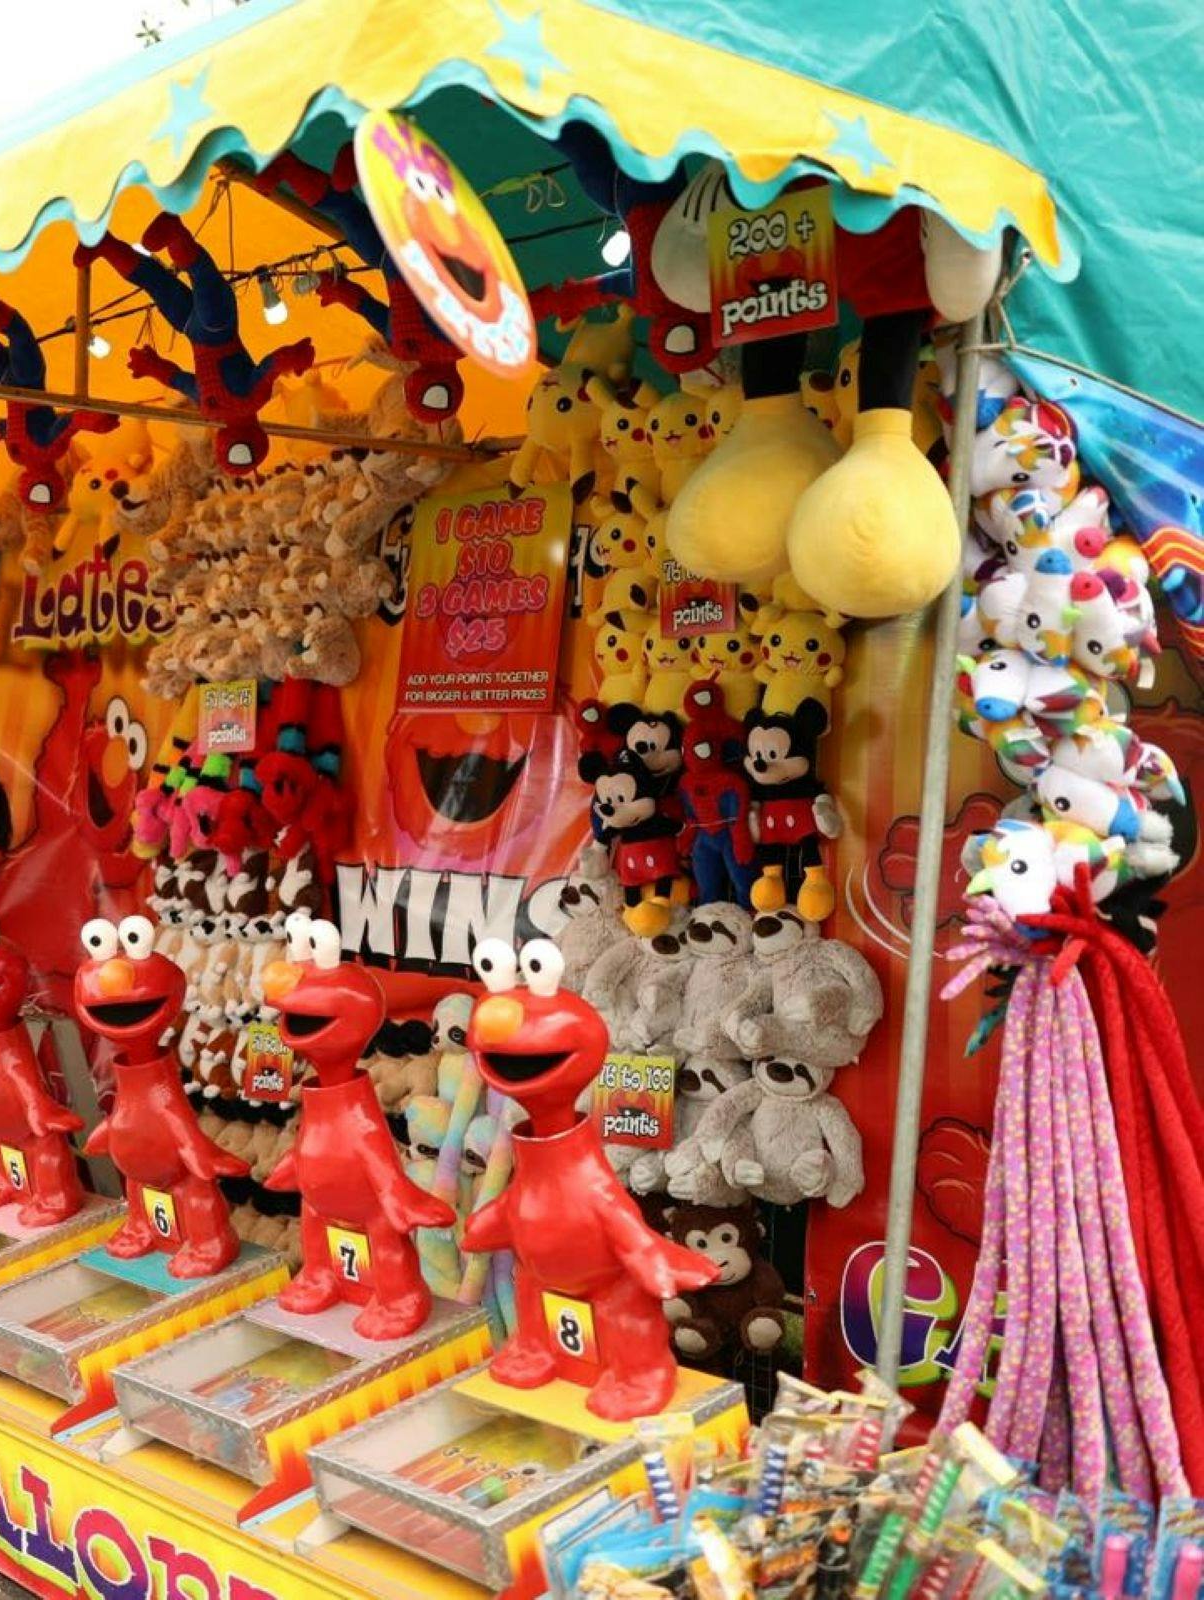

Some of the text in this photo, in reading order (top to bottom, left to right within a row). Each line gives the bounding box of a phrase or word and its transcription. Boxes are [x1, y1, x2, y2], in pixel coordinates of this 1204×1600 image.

[372, 121, 456, 193] BIG
[727, 210, 815, 260] 200 +
[398, 240, 535, 369] PRIZES
[720, 277, 829, 337] points
[456, 499, 546, 542] GAME
[457, 539, 514, 583] $10
[417, 574, 549, 618] 3 GAMES
[673, 600, 724, 632] points
[446, 615, 508, 659] $25
[406, 691, 423, 702] FOR
[425, 690, 462, 701] BIGGER
[471, 689, 509, 700] BETTER
[511, 689, 547, 700] PRIZES
[407, 671, 549, 686] ADD YOUR POINTS TOGETHER
[621, 1065, 640, 1089] to
[645, 1066, 672, 1093] 100
[603, 1109, 660, 1138] points
[9, 1158, 23, 1188] 5
[153, 1201, 170, 1236] 6
[339, 1242, 358, 1280] 7
[559, 1309, 582, 1355] 8
